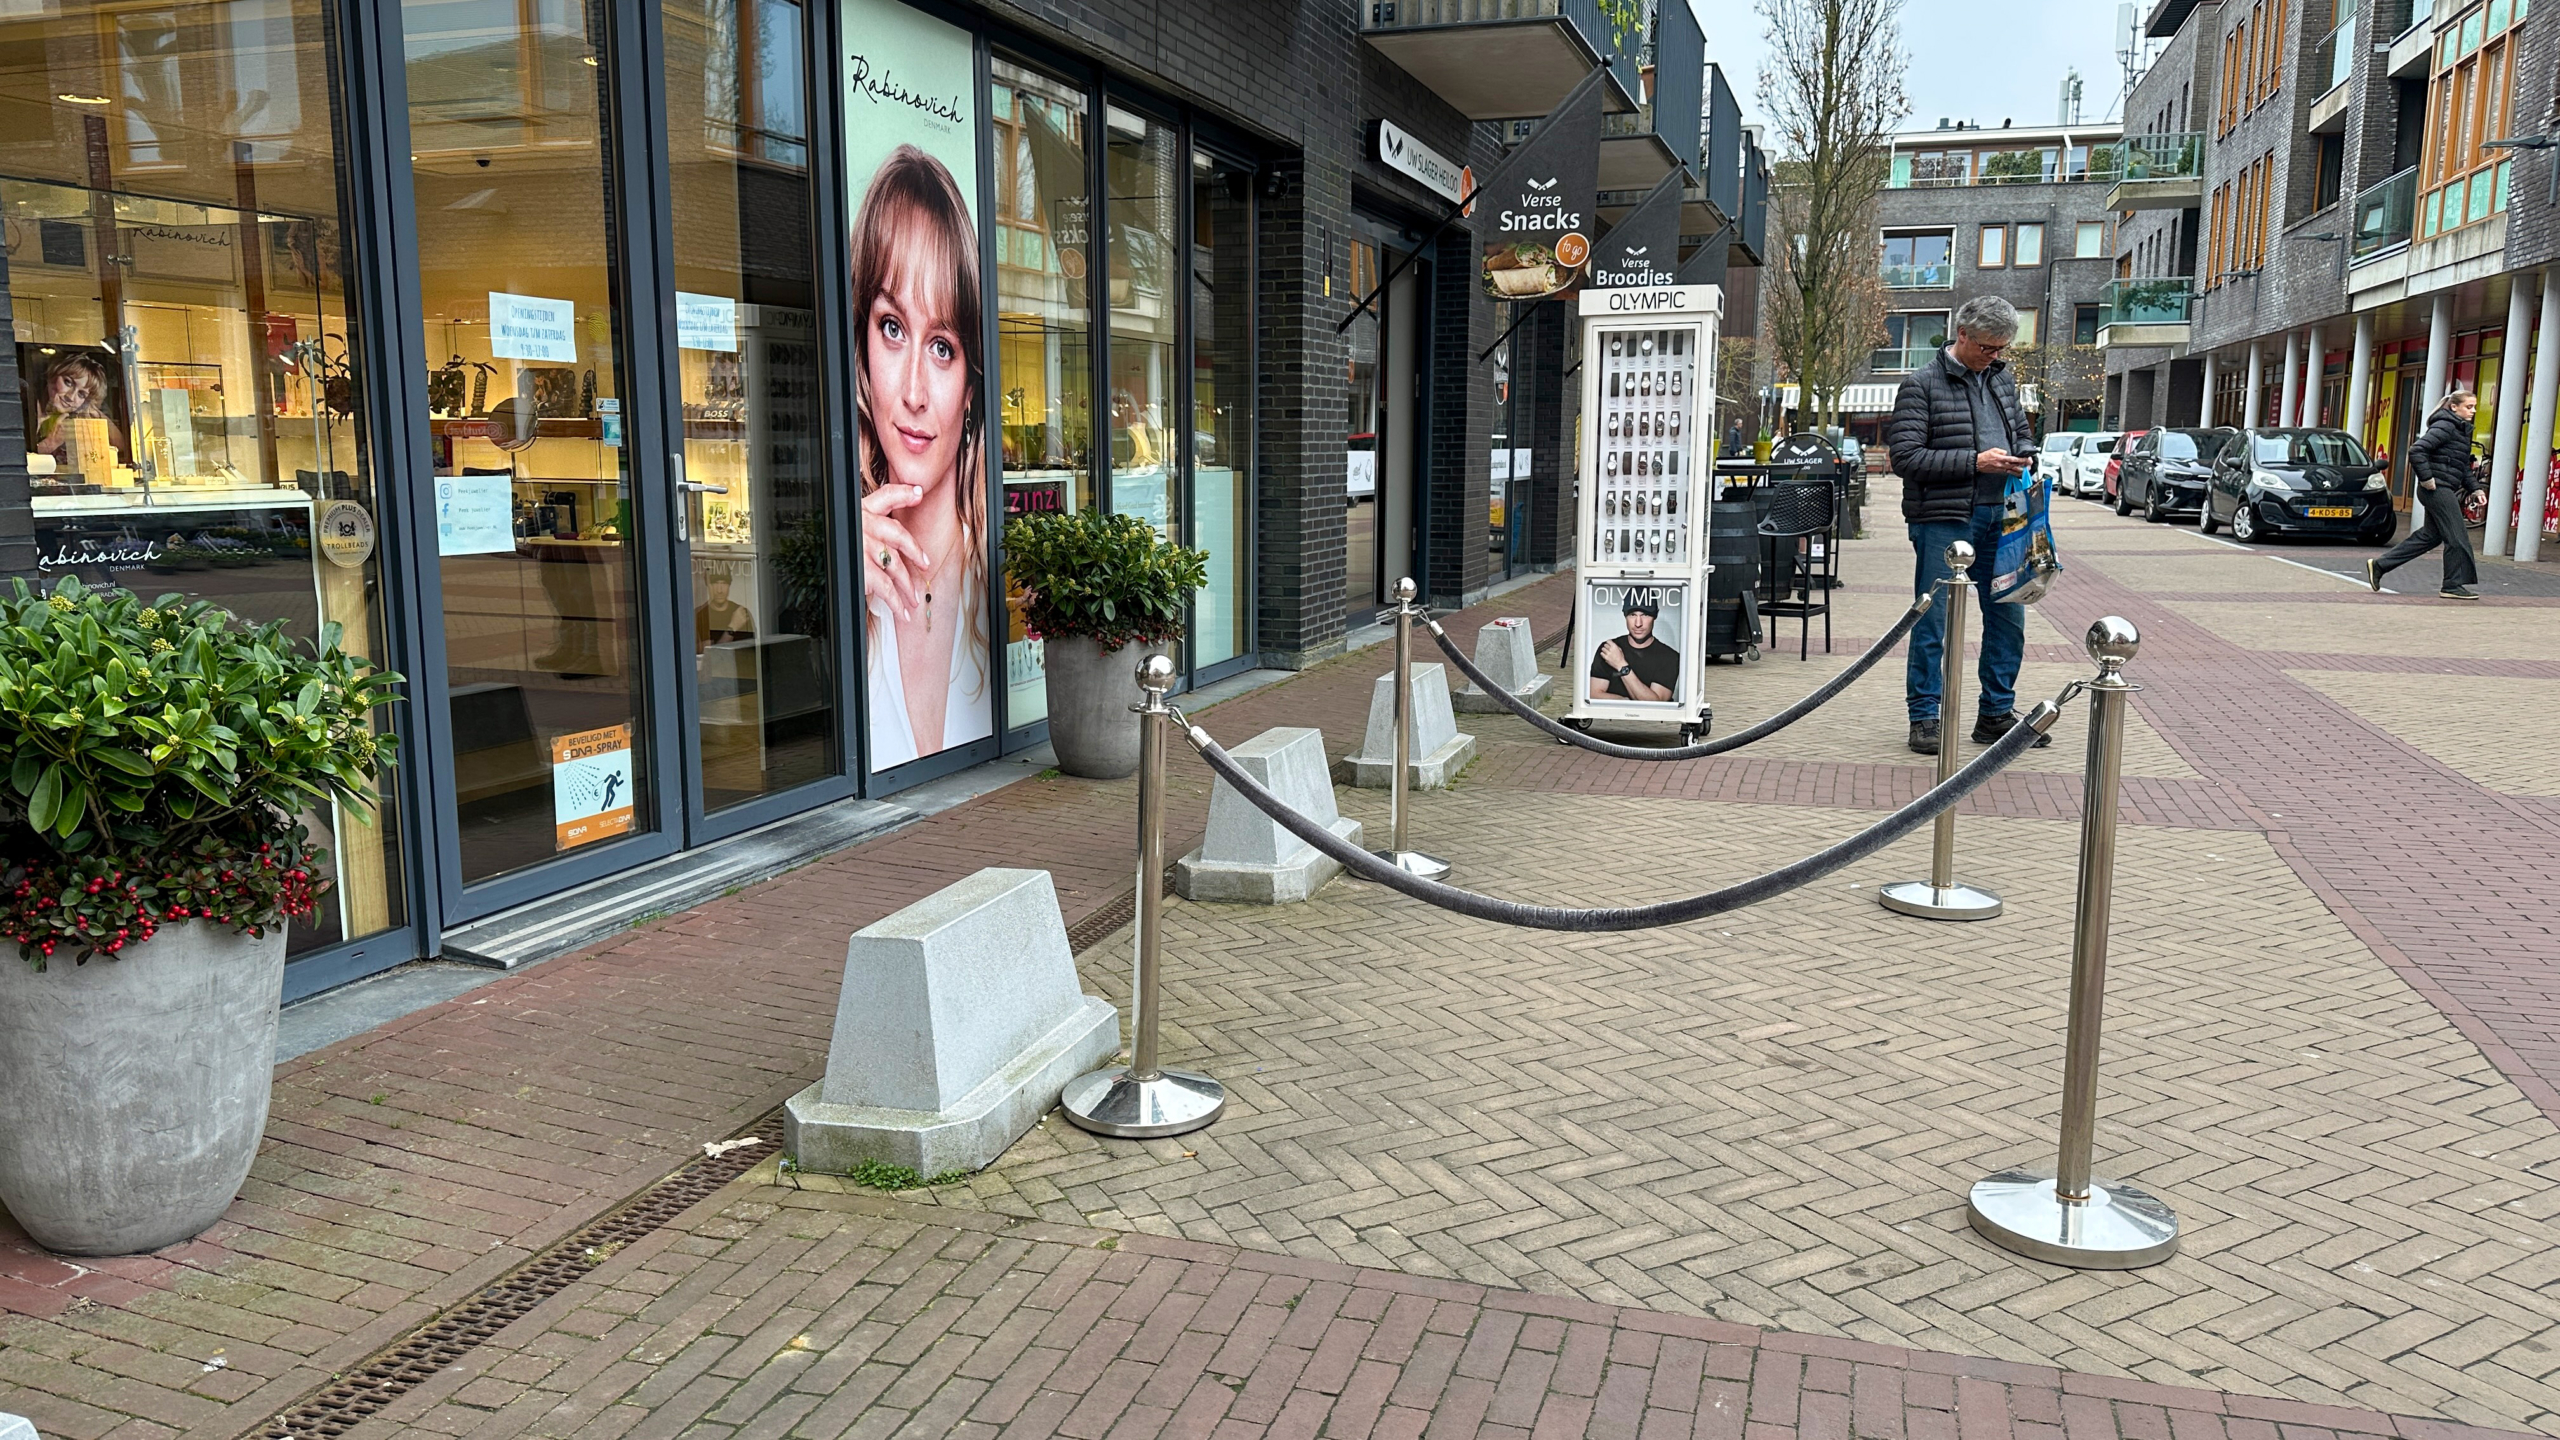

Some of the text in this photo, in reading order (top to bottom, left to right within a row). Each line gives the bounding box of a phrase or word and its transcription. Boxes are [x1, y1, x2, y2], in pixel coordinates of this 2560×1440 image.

[851, 55, 964, 123] Rabinovich
[924, 118, 951, 134] DENMARK
[1407, 147, 1417, 169] UW
[1418, 154, 1438, 181] SLAGER
[1439, 166, 1458, 194] HEILOO
[1521, 193, 1562, 208] Verse
[1499, 207, 1580, 231] Snacks
[1562, 240, 1583, 261] to go
[1621, 257, 1651, 268] Verse
[1596, 268, 1674, 287] Broodjes
[1609, 291, 1686, 310] OLYMPIC
[704, 410, 729, 418] BOSS
[1797, 457, 1823, 465] SLAGER
[323, 506, 341, 534] PREMIUM
[341, 504, 357, 513] PLUS
[2310, 509, 2350, 517] 4-KDS-85
[326, 541, 369, 550] TROLLBEADS
[109, 564, 146, 573] DENMARK
[1594, 587, 1681, 607] OLYMPIC
[568, 730, 617, 747] BEVEILIGD MET
